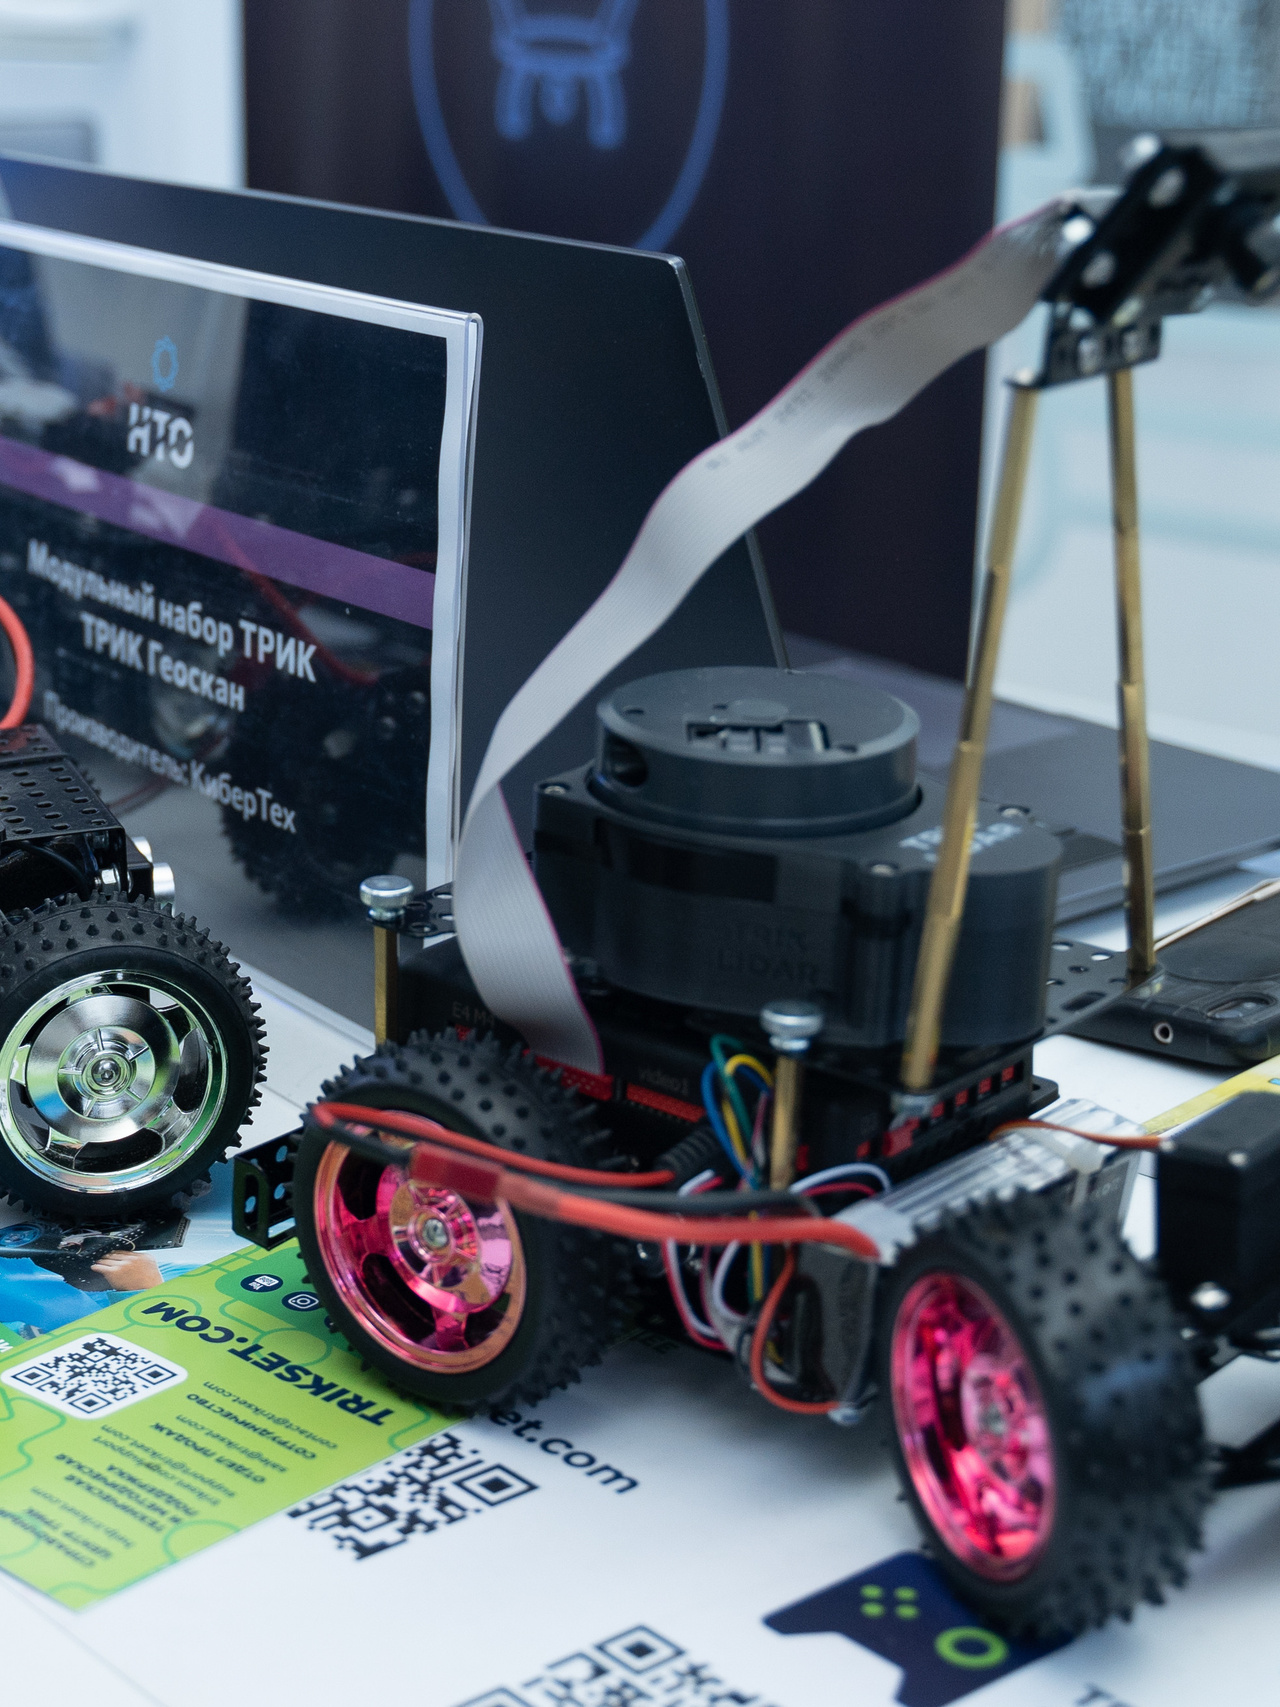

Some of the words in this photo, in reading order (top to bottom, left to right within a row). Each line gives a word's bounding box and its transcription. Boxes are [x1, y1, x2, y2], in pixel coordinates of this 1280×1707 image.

[26, 538, 155, 621] Модульный
[158, 601, 234, 657] набор
[238, 618, 317, 682] ТРИК
[80, 610, 144, 671] ТРИК
[147, 639, 245, 712] Геоскан
[190, 759, 297, 834] КиберТех
[141, 1301, 395, 1427] TRIKSET.COM
[150, 1421, 216, 1459] ПРОДАЖ
[175, 1413, 289, 1473] sale@trikset.com
[186, 1392, 317, 1460] СОТРУДНИЧЕСТВО
[203, 1380, 339, 1450] contact@trikset.com
[55, 1452, 168, 1517] МЕТОДИЧЕСКАЯ
[100, 1424, 236, 1498] support@trikset.com
[215, 1455, 267, 1485] ОТДЕЛ
[489, 1409, 639, 1494] et.com
[106, 1464, 199, 1517] ПОДДЕРЖКА
